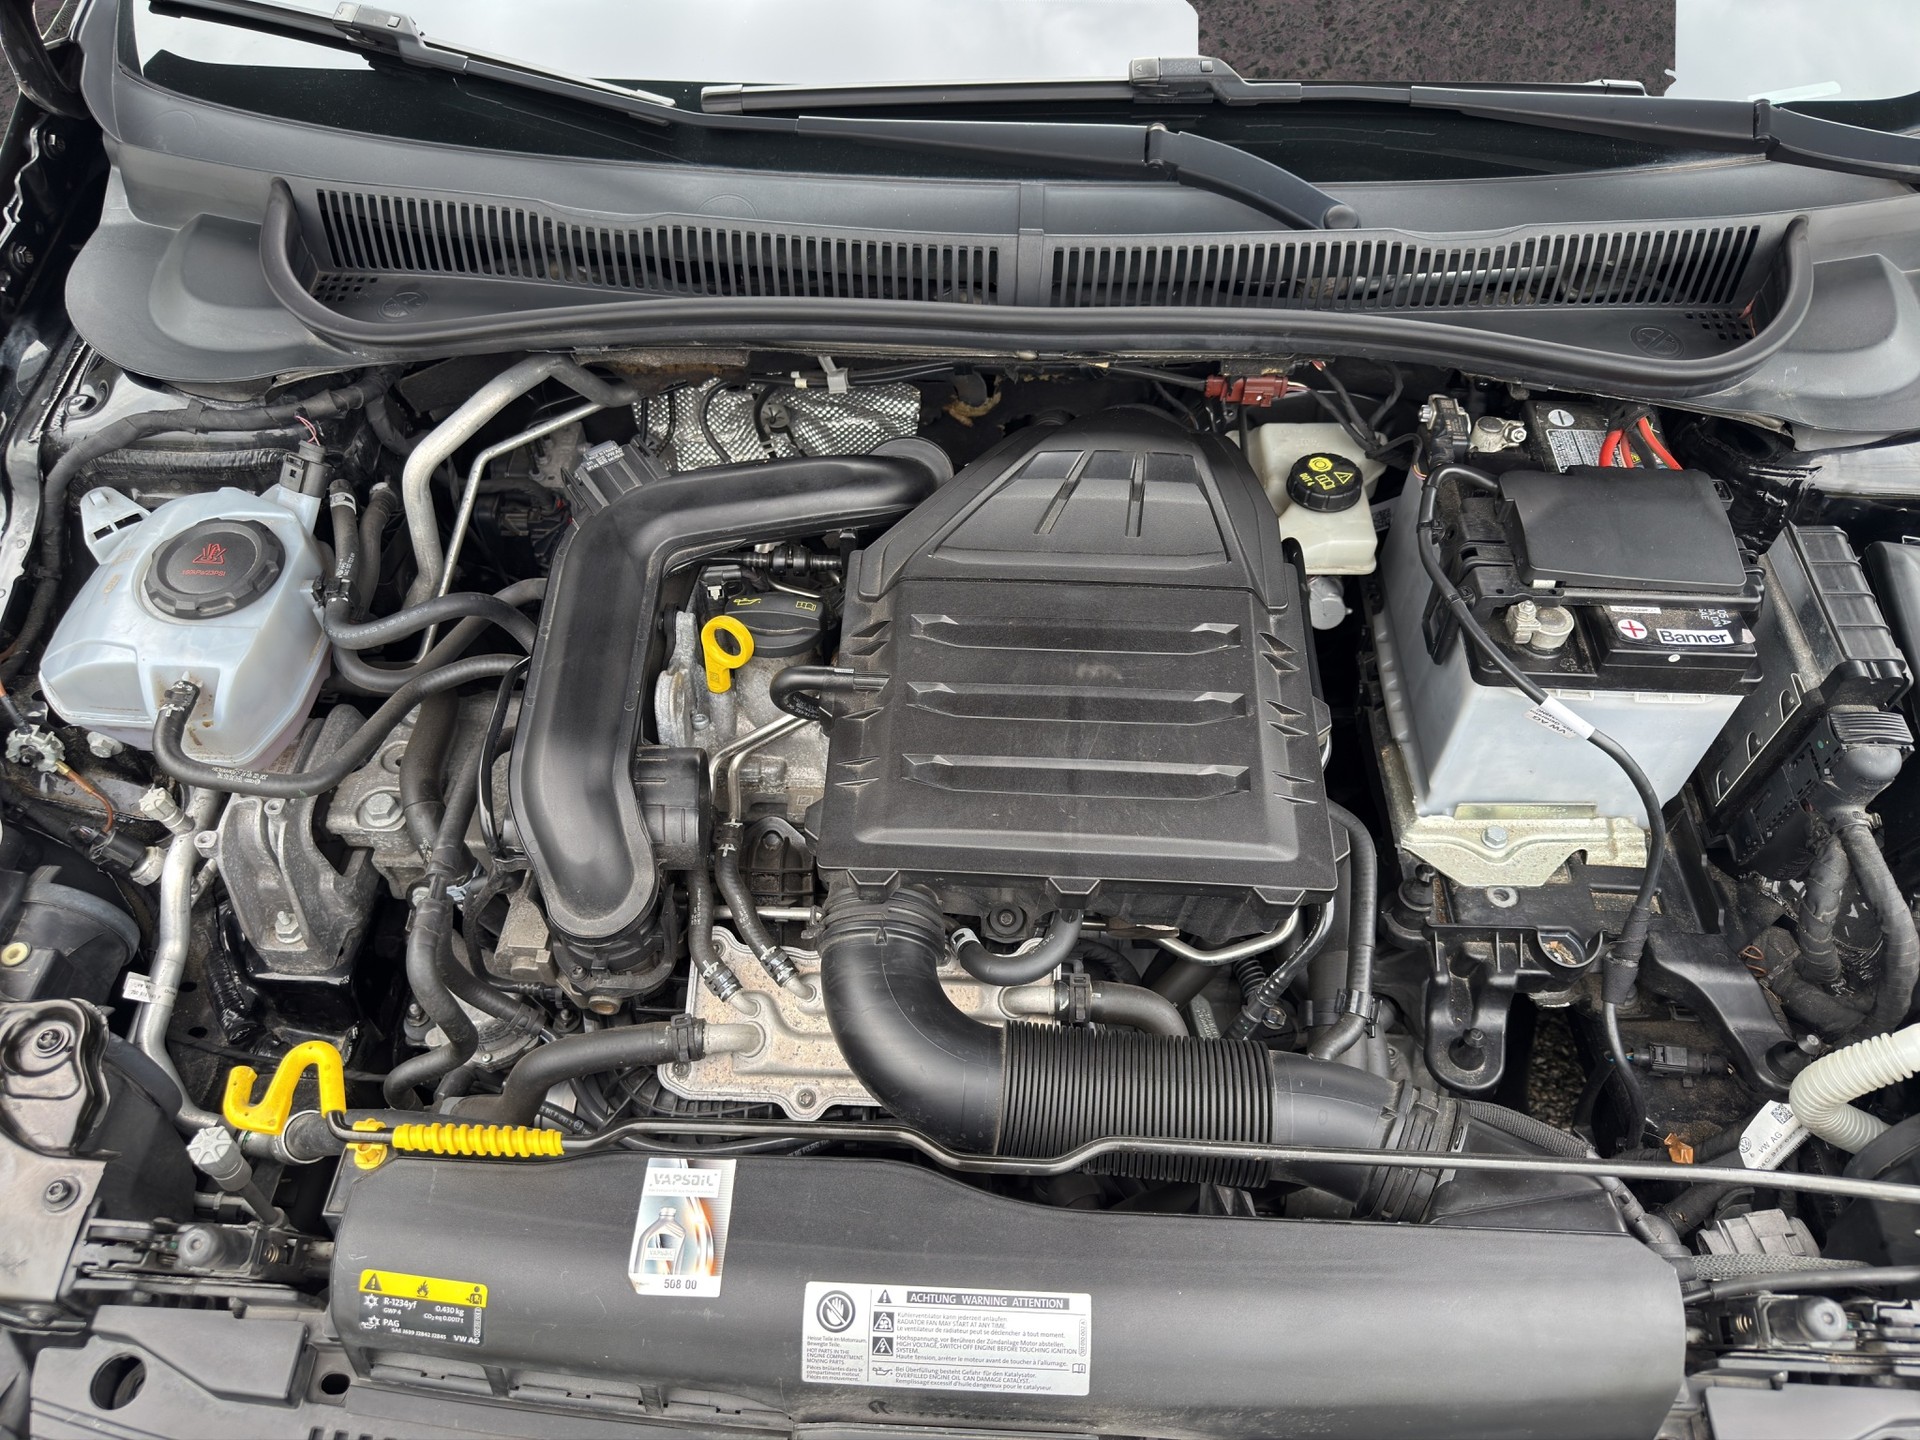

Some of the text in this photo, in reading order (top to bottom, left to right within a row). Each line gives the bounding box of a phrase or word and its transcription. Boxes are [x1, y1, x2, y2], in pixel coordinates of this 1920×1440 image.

[1661, 630, 1727, 643] Banner
[1759, 1132, 1782, 1153] VW AG
[664, 1278, 681, 1289] 508
[685, 1279, 697, 1290] 00
[910, 1293, 1064, 1309] ACHTUNG WARNING ATTENTION
[383, 1297, 465, 1317] R-1234yf 0.430 kg
[383, 1318, 400, 1328] PAG
[453, 1334, 467, 1342] VW
[1040, 1332, 1066, 1340] moment.
[986, 1338, 1019, 1347] Zündanlage
[906, 1366, 939, 1375] Überfüllung
